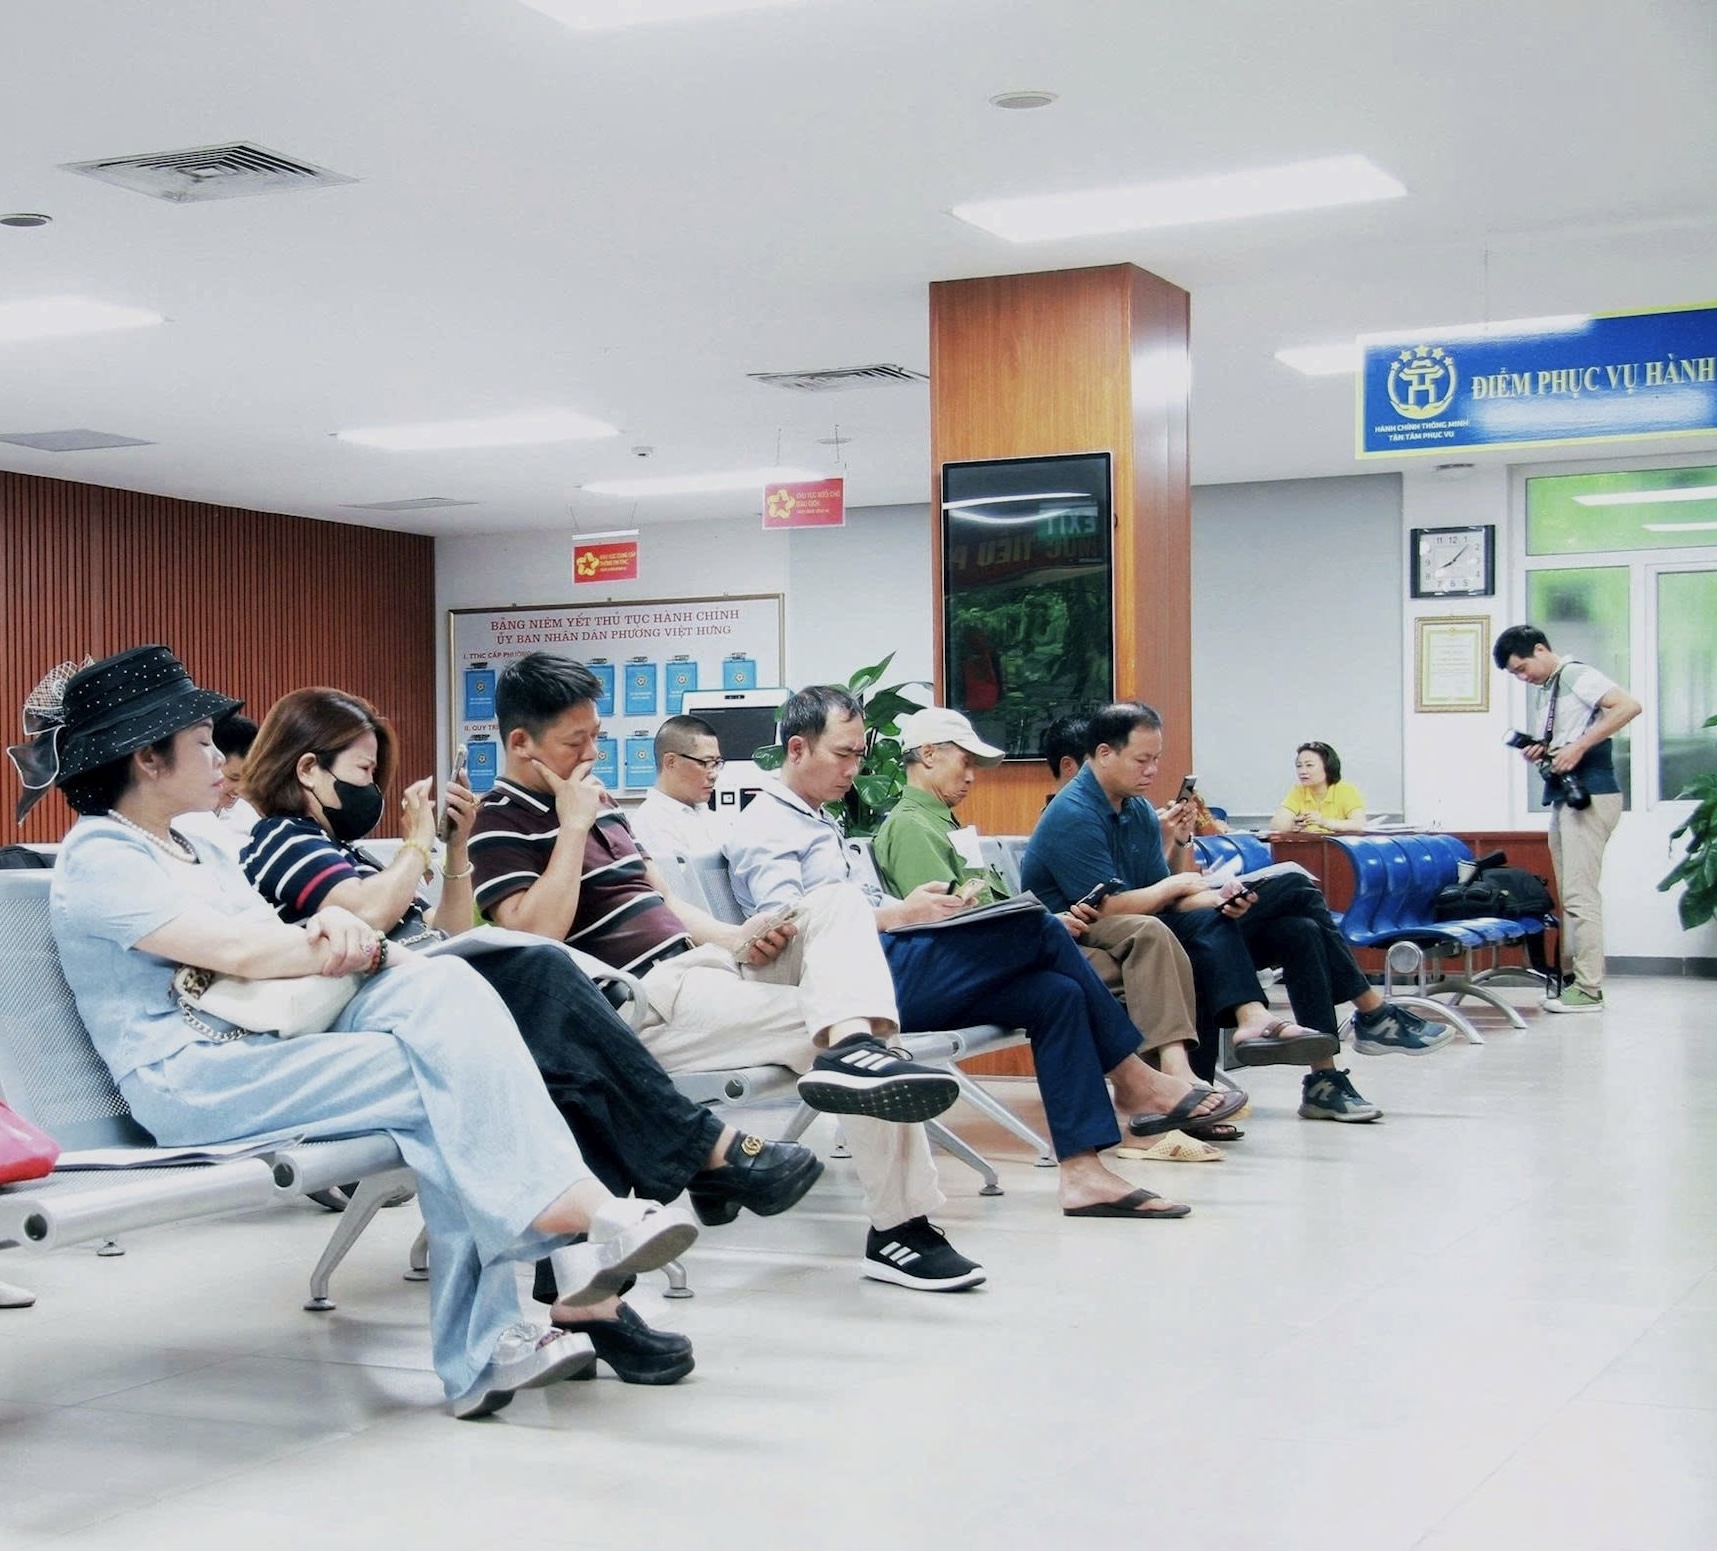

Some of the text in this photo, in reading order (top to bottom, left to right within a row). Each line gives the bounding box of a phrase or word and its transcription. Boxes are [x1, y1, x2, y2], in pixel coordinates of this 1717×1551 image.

[1471, 353, 1717, 400] ĐIỂM PHỤC VỤ HÀNH
[1447, 418, 1469, 427] MINH
[1449, 536, 1458, 544] 12
[491, 617, 526, 631] BẢNG
[565, 612, 592, 627] YẾT
[594, 611, 621, 626] THỦ
[624, 614, 650, 628] TỤC
[653, 610, 692, 623] HÀNH
[696, 607, 739, 621] CHÍNH
[516, 634, 541, 643] BAN
[544, 630, 578, 643] NHÂN
[582, 629, 607, 641] DÂN
[664, 625, 693, 638] VIỆT
